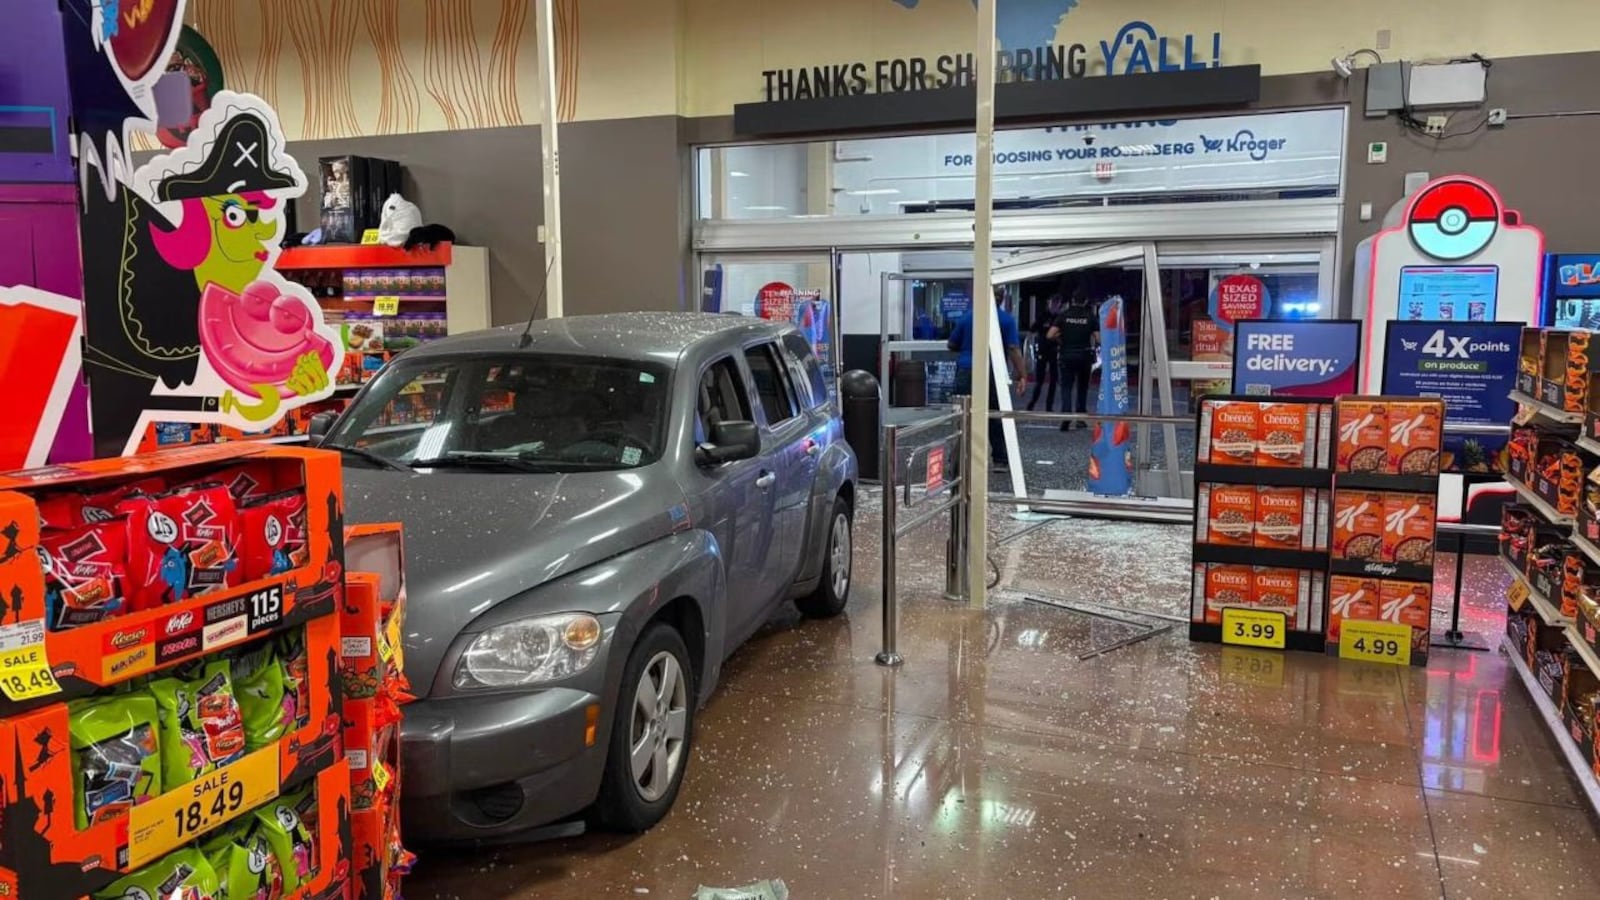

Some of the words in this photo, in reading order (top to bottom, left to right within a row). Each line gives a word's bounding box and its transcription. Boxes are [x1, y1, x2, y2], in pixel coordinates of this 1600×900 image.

[762, 62, 867, 101] THANKS
[875, 57, 927, 94] FOR
[936, 43, 1087, 90] SHPPING
[1100, 21, 1221, 77] Y'ALL!
[945, 155, 973, 167] FOR
[993, 149, 1052, 164] OOSING
[1056, 147, 1097, 161] YOUR
[1227, 130, 1287, 161] Kroger
[1222, 284, 1258, 294] TEXAS
[1222, 293, 1257, 303] SIZED
[1221, 302, 1257, 310] SAVINGS
[1065, 317, 1088, 325] POLICE
[1247, 333, 1294, 351] FREE
[1469, 341, 1511, 353] points
[1425, 361, 1437, 369] on
[1440, 361, 1480, 370] produce
[206, 598, 246, 622] HERSHEY'S
[250, 588, 280, 617] 115
[252, 612, 279, 630] pieces
[20, 632, 44, 646] 21.99
[1234, 622, 1275, 640] 3.99
[1353, 638, 1398, 656] 4.99
[4, 652, 38, 668] SALE
[2, 669, 54, 695] 18.49
[194, 772, 229, 798] SALE
[174, 781, 243, 838] 18.49
